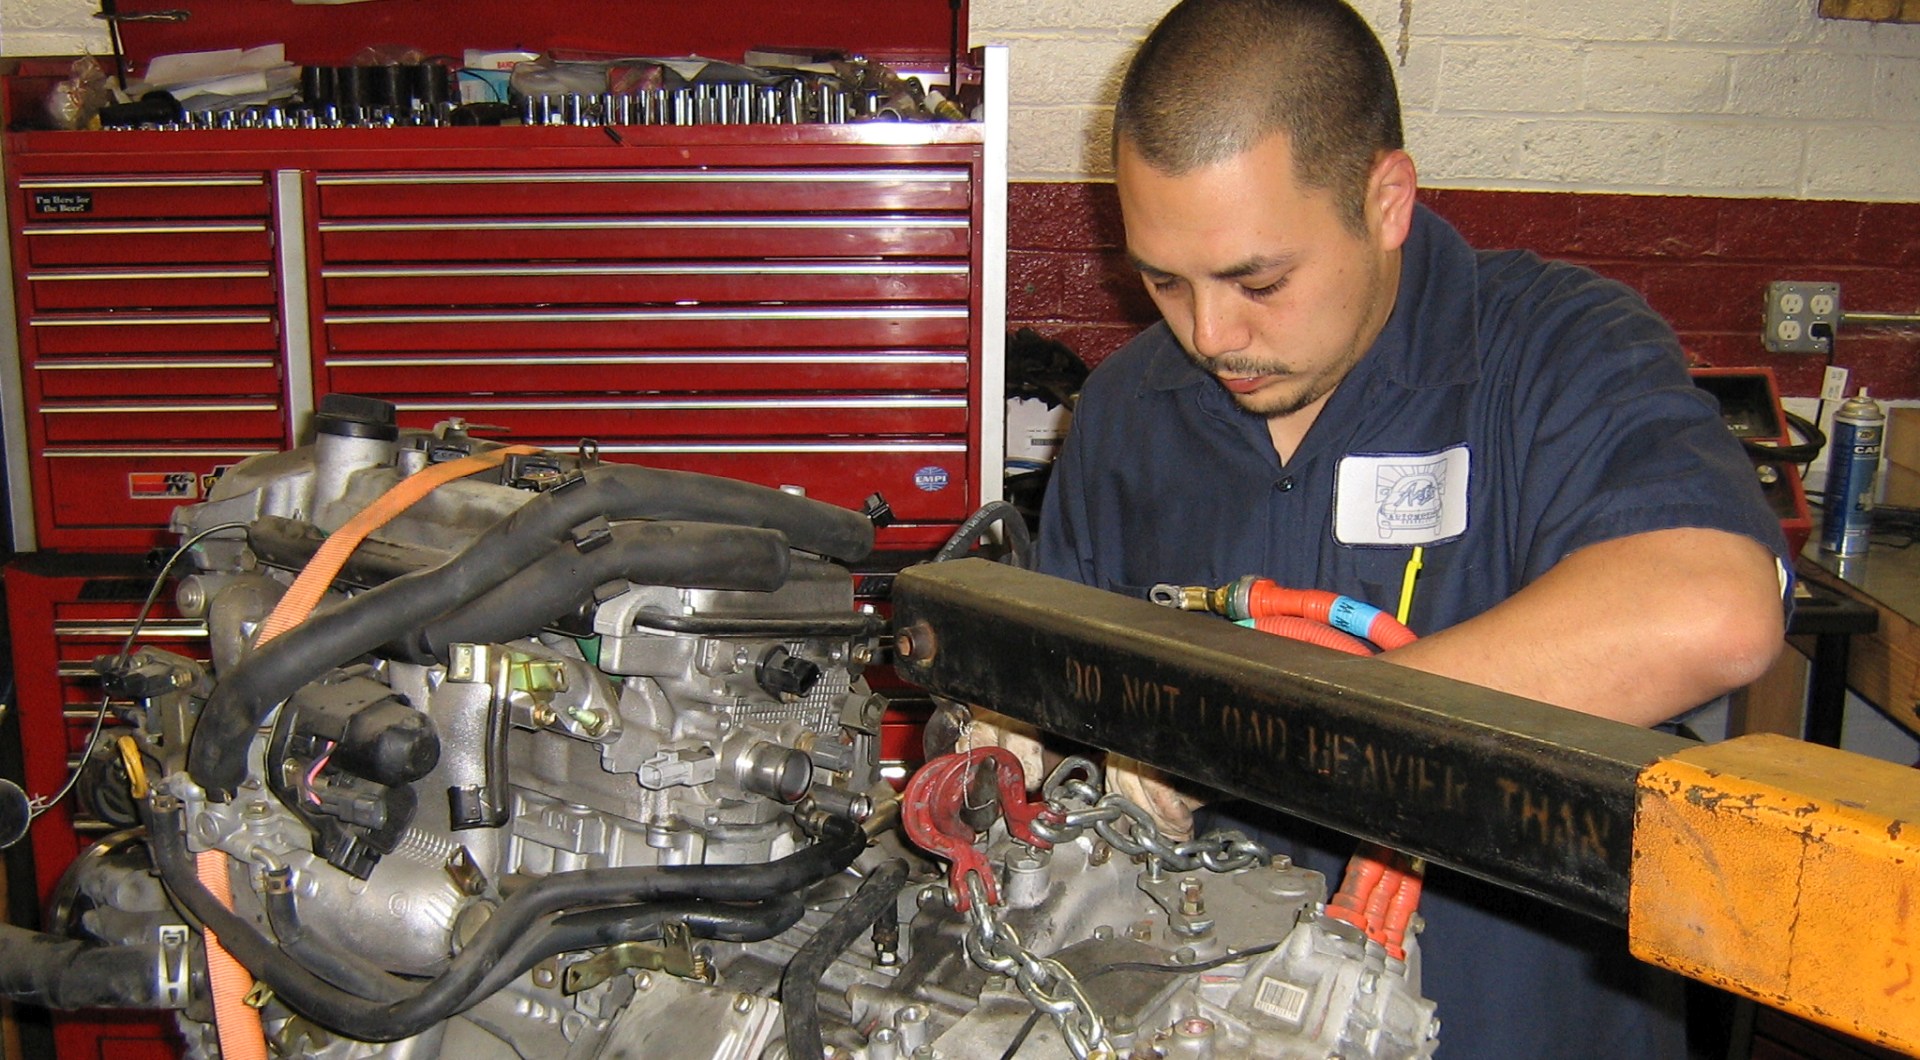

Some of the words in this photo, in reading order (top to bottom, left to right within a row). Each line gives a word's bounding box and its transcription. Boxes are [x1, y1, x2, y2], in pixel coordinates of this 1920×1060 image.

[915, 475, 947, 483] EMPI
[1065, 655, 1102, 704] DO
[1122, 673, 1182, 723] NOT
[1200, 696, 1288, 764] LOAD
[1307, 725, 1468, 813] HEAVIER
[1496, 777, 1612, 860] THAN
